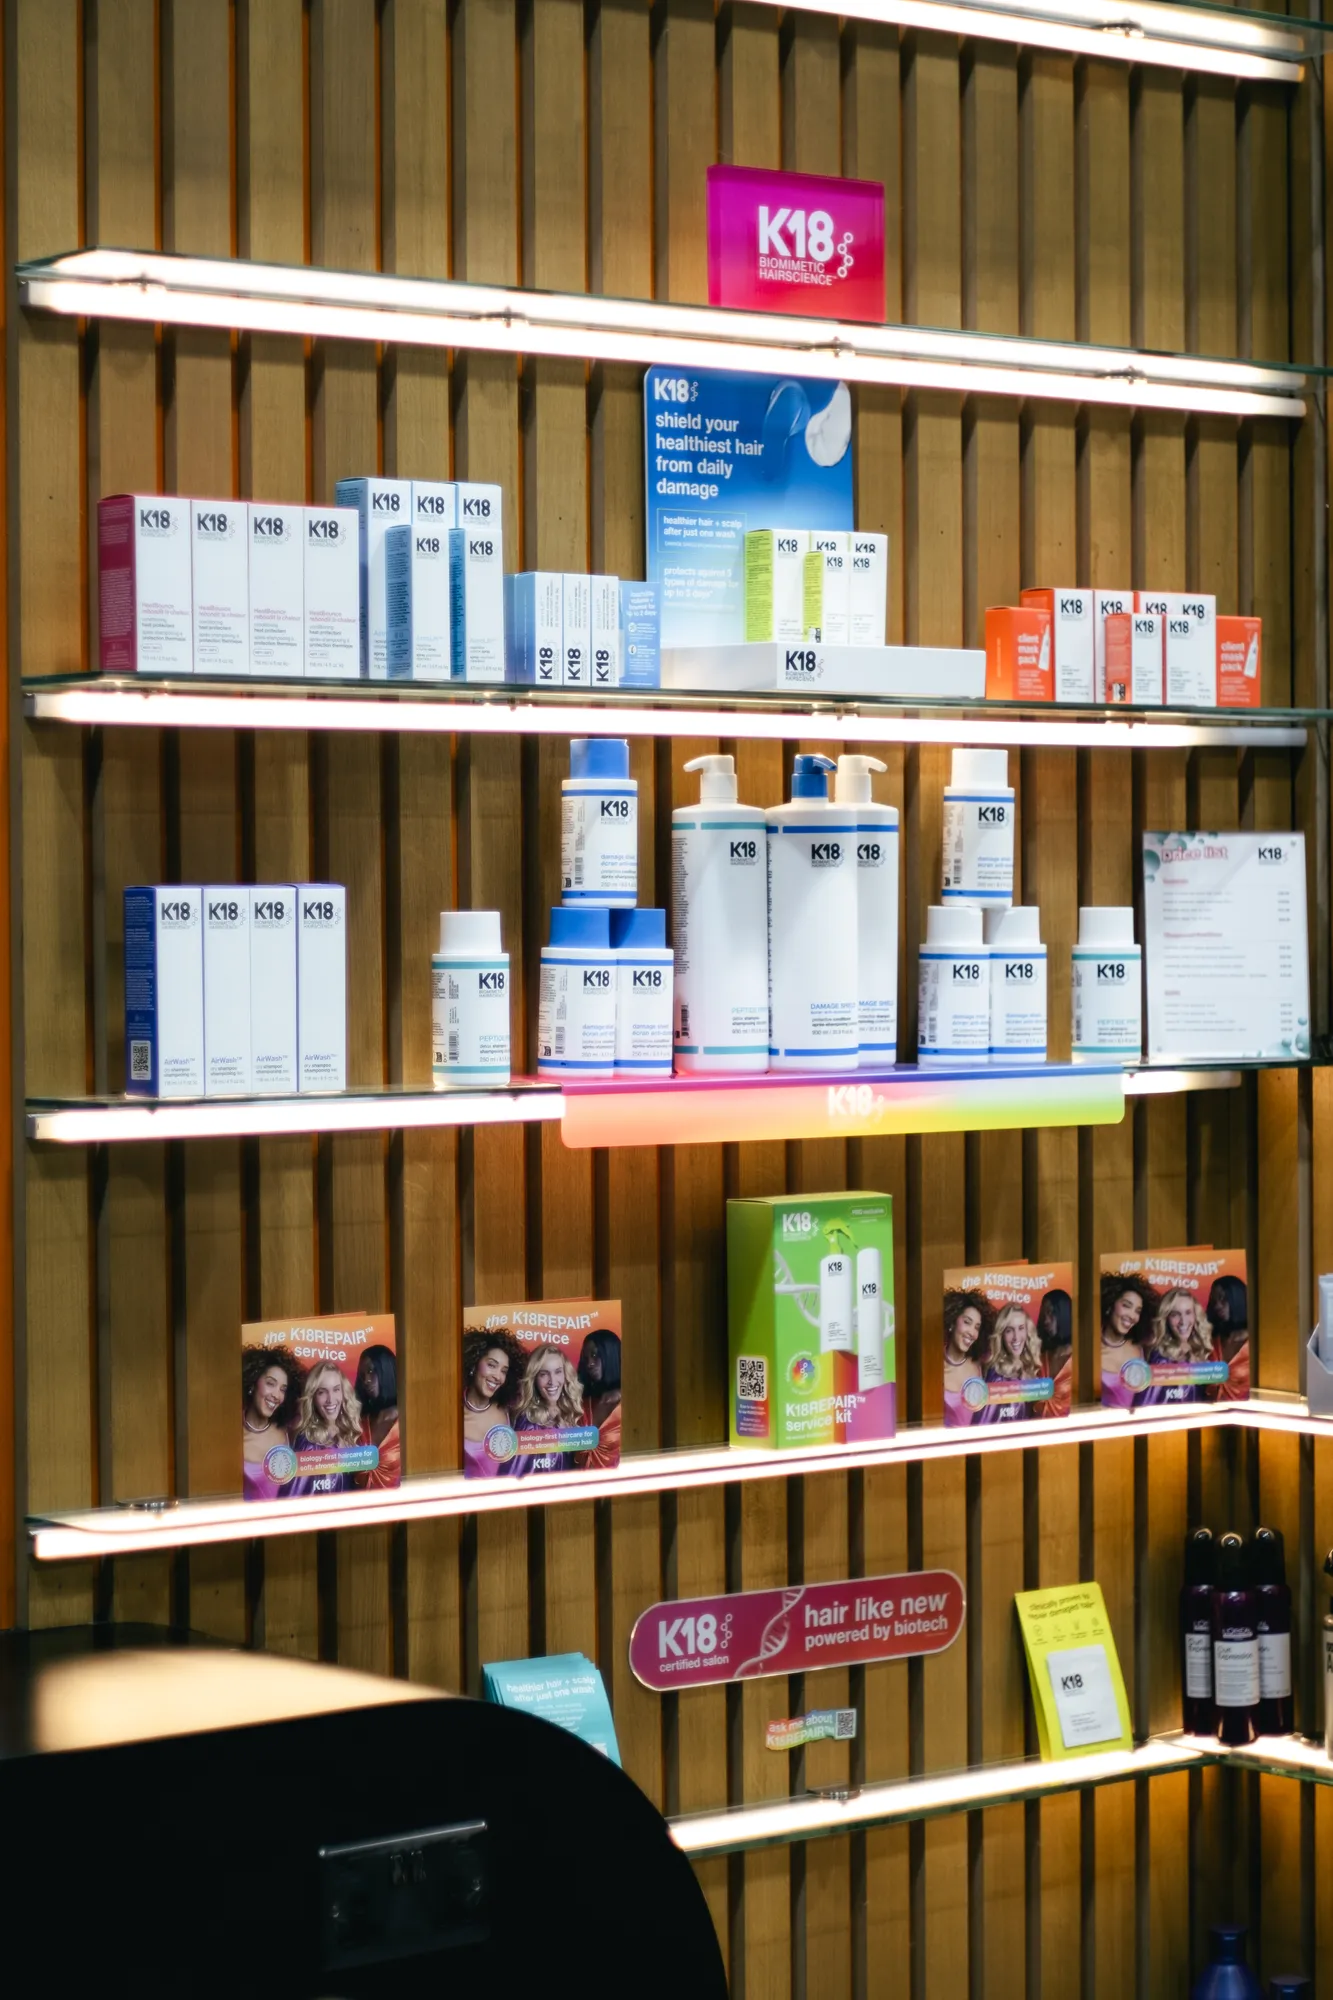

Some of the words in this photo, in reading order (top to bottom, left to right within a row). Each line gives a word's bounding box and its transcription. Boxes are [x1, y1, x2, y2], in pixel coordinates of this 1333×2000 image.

[759, 205, 834, 261] K18
[759, 257, 825, 272] BIOMIMETIC
[654, 378, 689, 402] K18
[656, 412, 701, 430] shield
[706, 417, 739, 434] your
[656, 434, 731, 454] healthiest
[736, 440, 764, 456] hair
[656, 456, 693, 473] from
[697, 459, 733, 479] daily
[657, 479, 718, 499] damage
[372, 492, 400, 512] K18
[417, 496, 445, 514] K18
[463, 498, 491, 517] K18
[140, 510, 170, 530] K18
[197, 513, 228, 532] K18
[254, 517, 284, 537] K18
[664, 516, 696, 526] healthier
[698, 518, 714, 526] hair
[721, 520, 742, 529] scalp
[308, 520, 338, 539] K18
[664, 528, 682, 536] after
[682, 529, 698, 538] just
[716, 530, 736, 538] wash
[416, 538, 440, 552] K18
[470, 540, 494, 556] K18
[778, 538, 798, 552] K18
[816, 541, 836, 552] K18
[855, 543, 876, 554] K18
[826, 556, 843, 568] K18
[853, 558, 870, 568] K18
[1060, 598, 1082, 614] K18
[1101, 600, 1123, 614] K18
[1146, 602, 1168, 614] K18
[1182, 604, 1205, 620] K18
[1135, 620, 1154, 634] K18
[1170, 620, 1190, 634] K18
[1018, 634, 1039, 644] client
[1220, 641, 1245, 652] client
[1018, 646, 1039, 654] mask
[1220, 652, 1244, 662] mask
[539, 646, 554, 680] K18
[567, 648, 582, 681] K18
[596, 650, 610, 682] K18
[786, 650, 816, 672] K18
[1018, 655, 1036, 666] pack
[1220, 663, 1242, 672] pack
[601, 800, 628, 818] K18
[978, 806, 1004, 822] K18
[730, 841, 756, 858] K18
[812, 843, 840, 860] K18
[1258, 847, 1282, 860] K18
[162, 902, 190, 920] K18
[208, 902, 238, 920] K18
[254, 902, 284, 920] K18
[304, 902, 334, 920] K18
[584, 970, 610, 987] K18
[632, 970, 662, 987] K18
[953, 964, 980, 980] K18
[1006, 964, 1033, 979] K18
[1098, 964, 1125, 979] K18
[479, 972, 504, 989] K18
[828, 1084, 873, 1117] K18
[782, 1212, 812, 1233] K18
[828, 1262, 842, 1272] K18
[1120, 1259, 1142, 1274] the
[862, 1283, 876, 1294] K18
[962, 1274, 982, 1290] the
[1148, 1273, 1200, 1290] service
[986, 1288, 1032, 1304] service
[486, 1314, 508, 1329] the
[264, 1331, 286, 1346] the
[516, 1328, 570, 1345] service
[294, 1345, 346, 1361] service
[1166, 1389, 1184, 1400] K18
[786, 1414, 832, 1432] service
[836, 1409, 852, 1424] kit
[520, 1434, 558, 1442] biology-first
[558, 1431, 583, 1440] haircare
[558, 1440, 580, 1448] bouncy
[300, 1453, 336, 1462] biology-first
[338, 1451, 362, 1460] haircare
[338, 1460, 360, 1468] bouncy
[534, 1458, 551, 1468] K18
[314, 1479, 331, 1490] K18
[804, 1600, 848, 1628] hair
[855, 1596, 894, 1622] like
[901, 1593, 949, 1616] new
[658, 1613, 717, 1659] K18
[805, 1624, 870, 1650] powered
[873, 1622, 892, 1640] by
[894, 1614, 948, 1637] biotech
[660, 1658, 701, 1672] certified
[702, 1654, 729, 1667] salon
[506, 1682, 544, 1693] healthier
[546, 1679, 562, 1689] hair
[572, 1676, 596, 1684] scalp
[1061, 1673, 1084, 1691] K18
[536, 1691, 552, 1702] just
[554, 1689, 570, 1698] one
[572, 1686, 596, 1694] wash
[769, 1722, 788, 1732] ask
[788, 1720, 804, 1730] me
[806, 1714, 833, 1726] about
